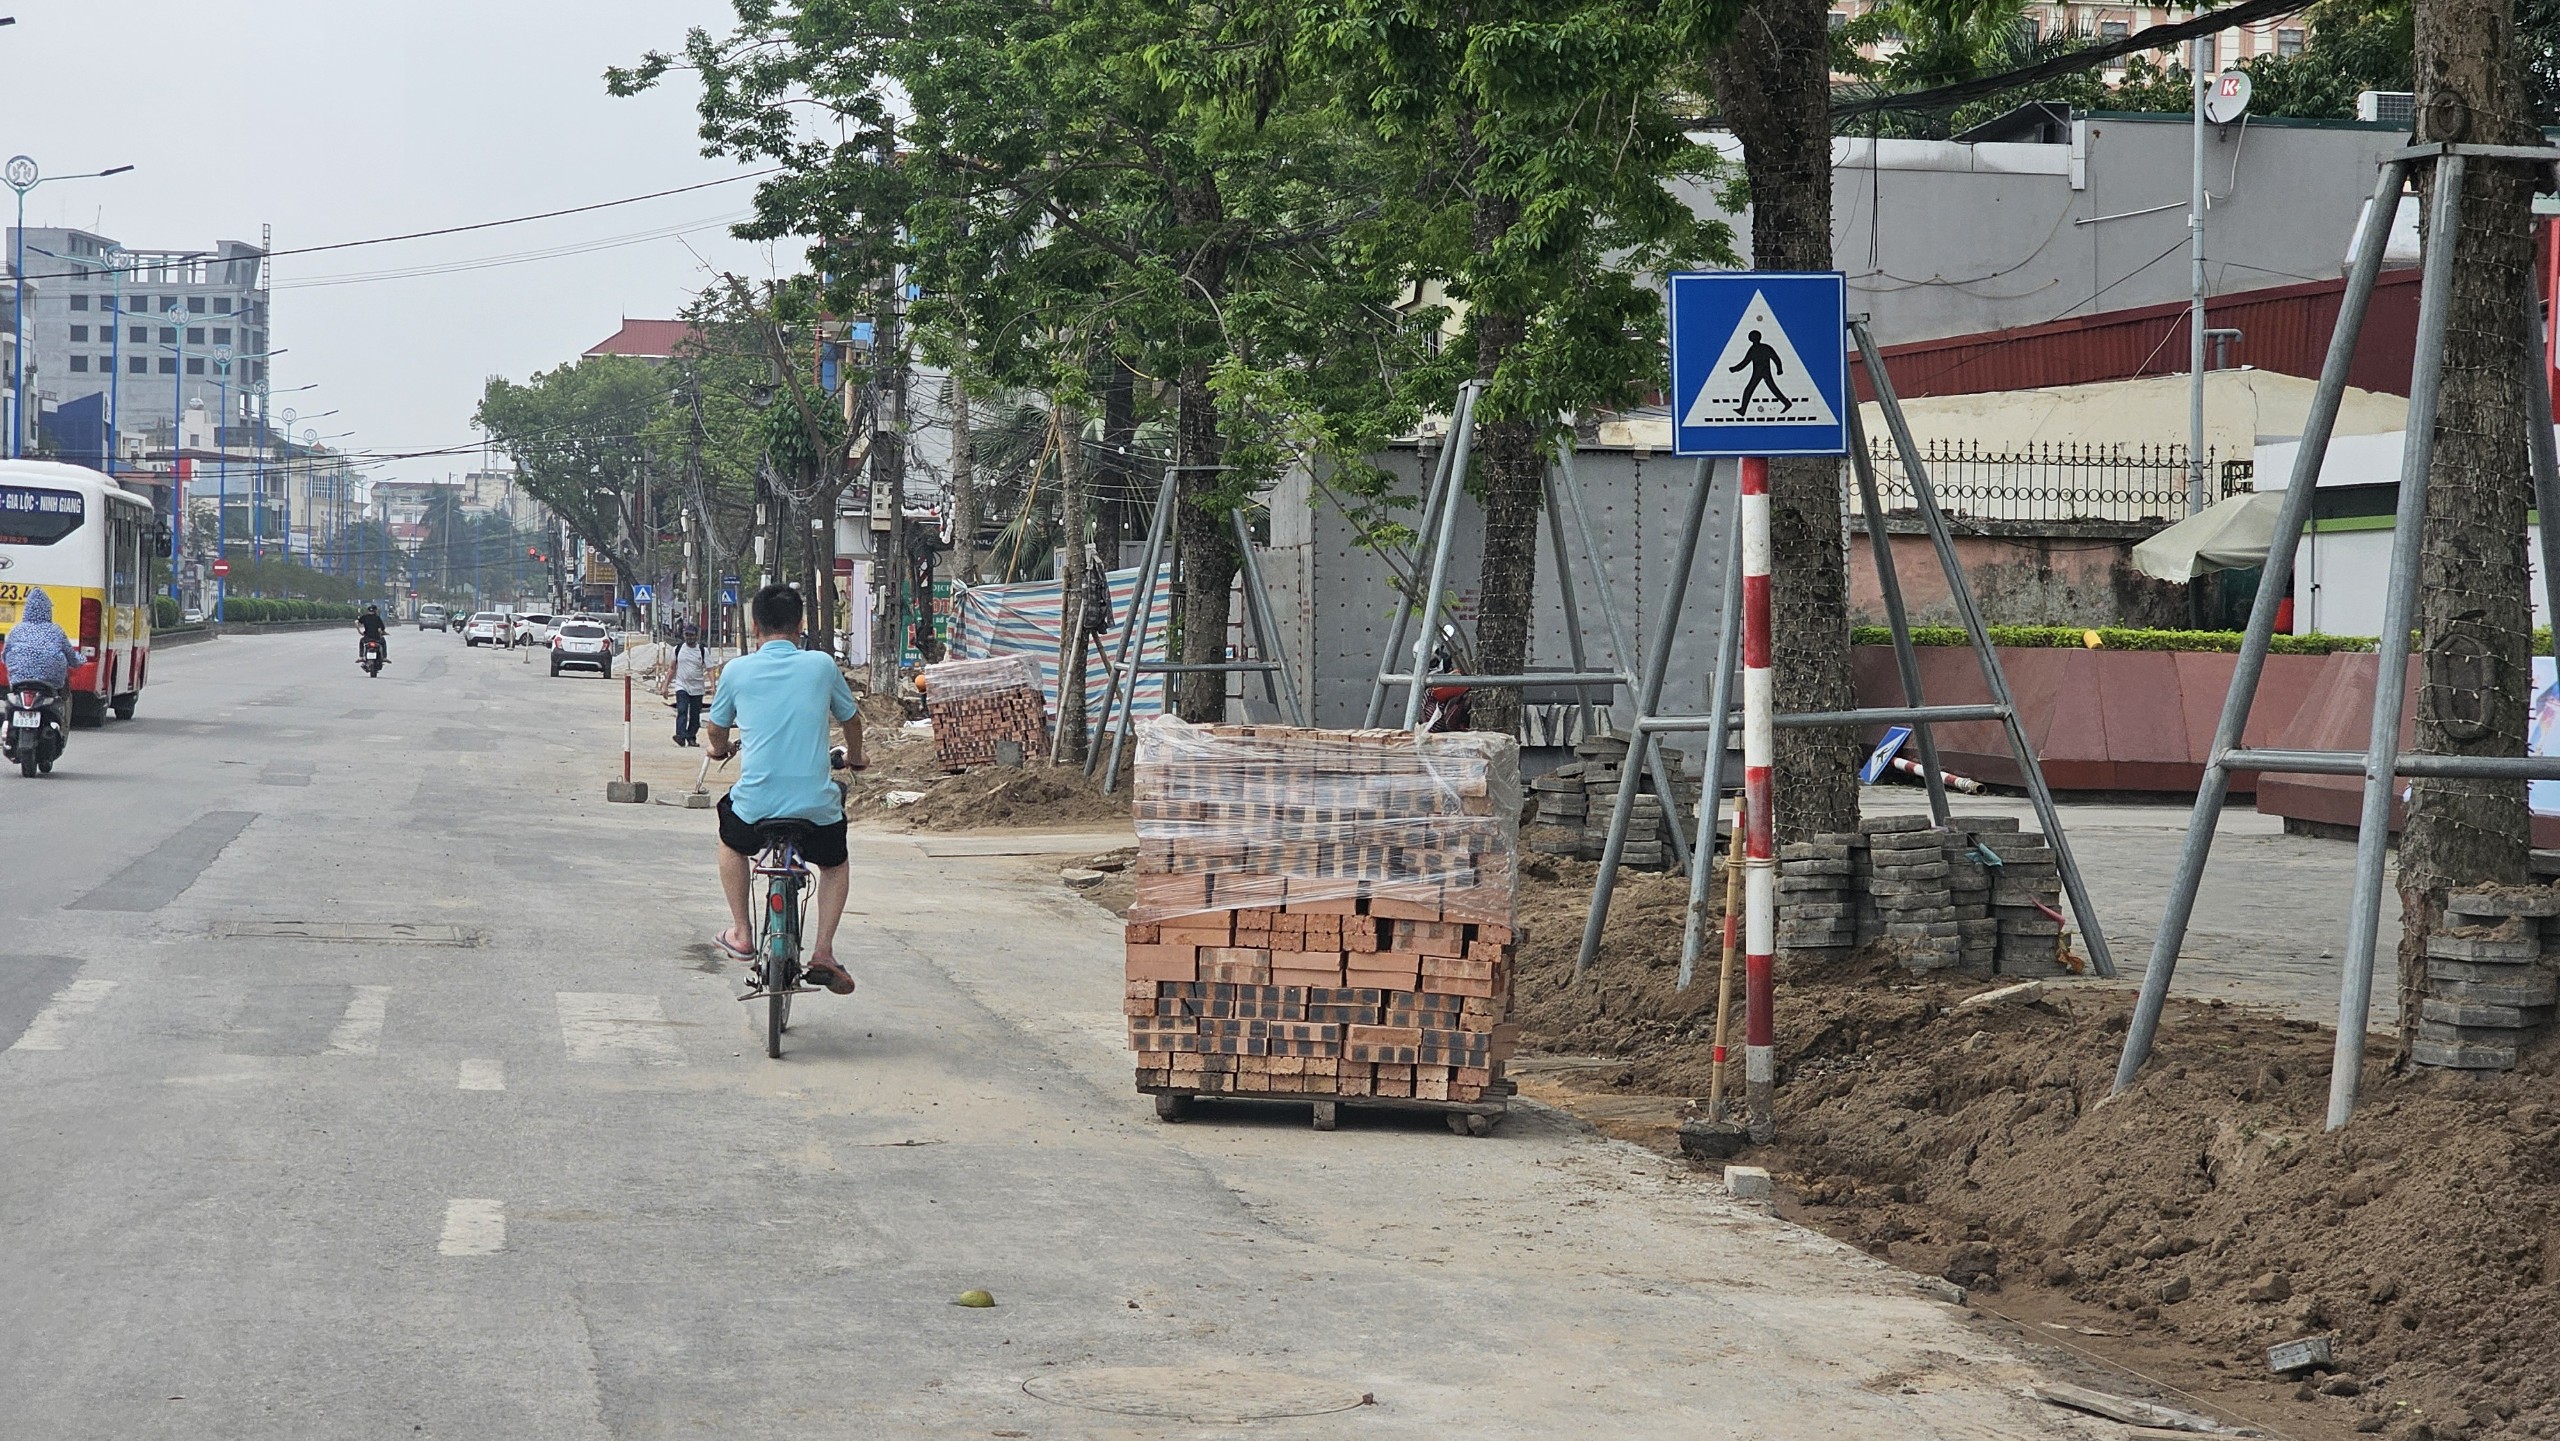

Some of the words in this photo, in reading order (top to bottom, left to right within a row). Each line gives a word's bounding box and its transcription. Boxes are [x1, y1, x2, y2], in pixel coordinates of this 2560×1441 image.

[6, 494, 18, 509] GIA
[20, 492, 34, 512] LỘC
[40, 496, 58, 512] NINH
[59, 498, 81, 513] GIANG
